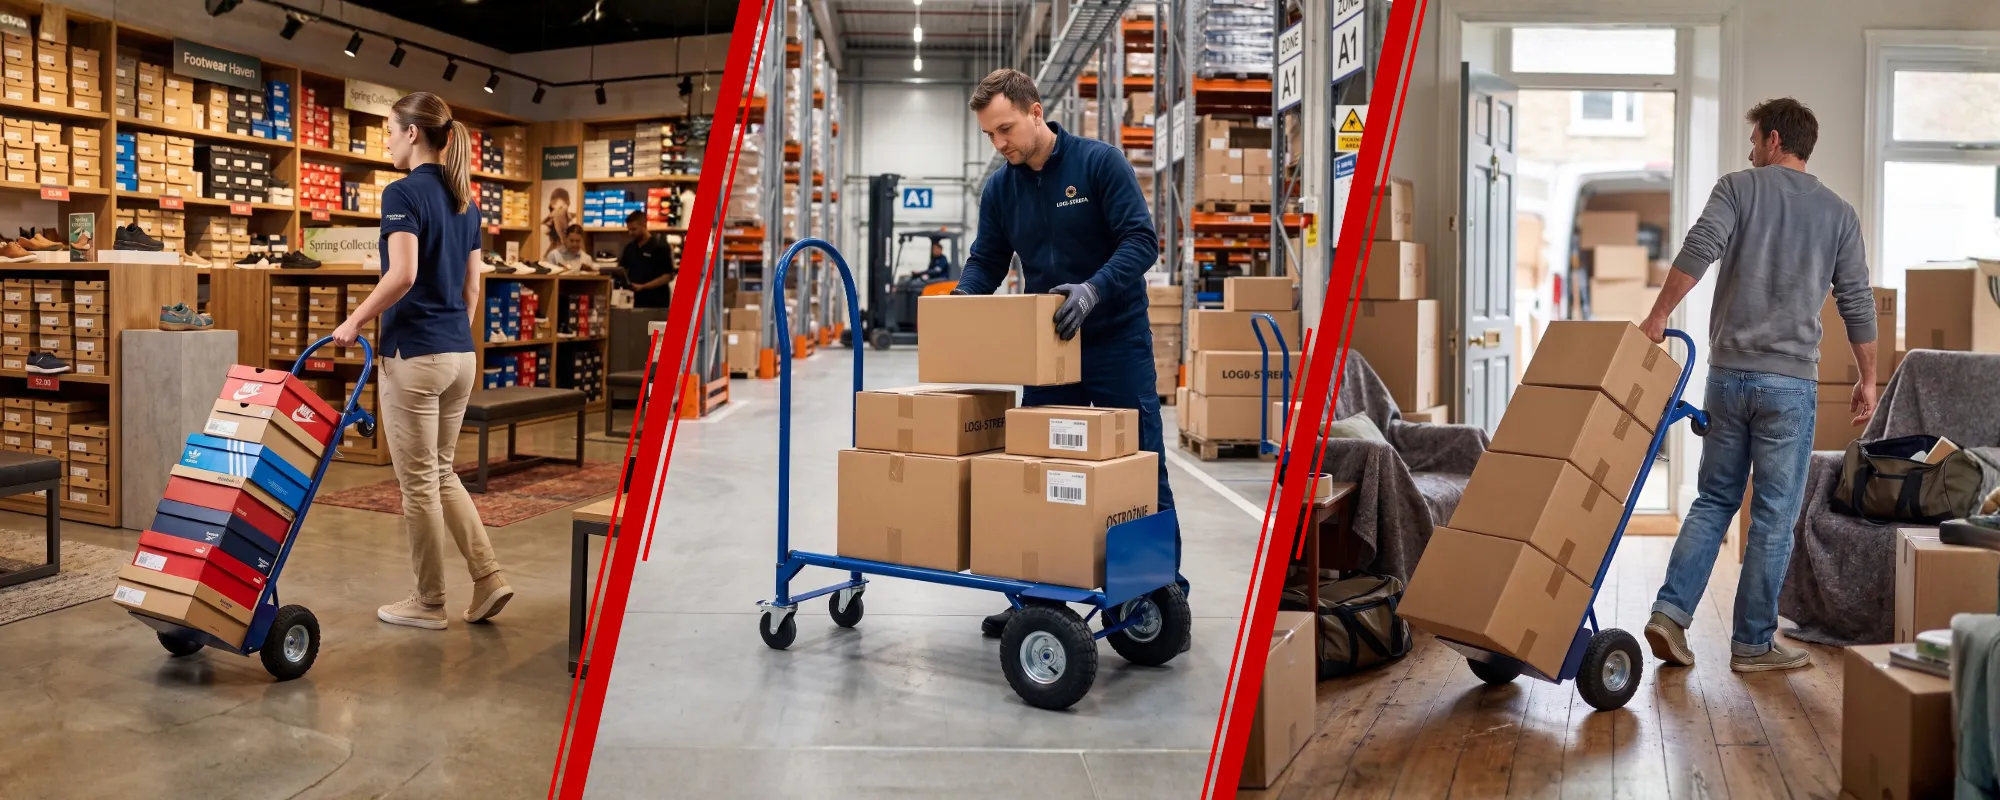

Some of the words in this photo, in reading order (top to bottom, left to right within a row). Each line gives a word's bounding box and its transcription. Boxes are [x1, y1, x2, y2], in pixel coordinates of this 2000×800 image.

[1281, 31, 1299, 55] ZONE
[1337, 26, 1357, 69] A1
[183, 51, 227, 73] Footwear
[229, 62, 255, 79] Haven
[1282, 65, 1297, 101] A1
[350, 88, 371, 104] Spring
[371, 93, 395, 106] Collecti
[906, 190, 929, 206] A1
[309, 239, 339, 253] Spring
[340, 239, 380, 250] Collectio
[240, 382, 263, 394] NIKE
[297, 403, 316, 421] NIKE
[964, 416, 1006, 433] LOGI-STREF
